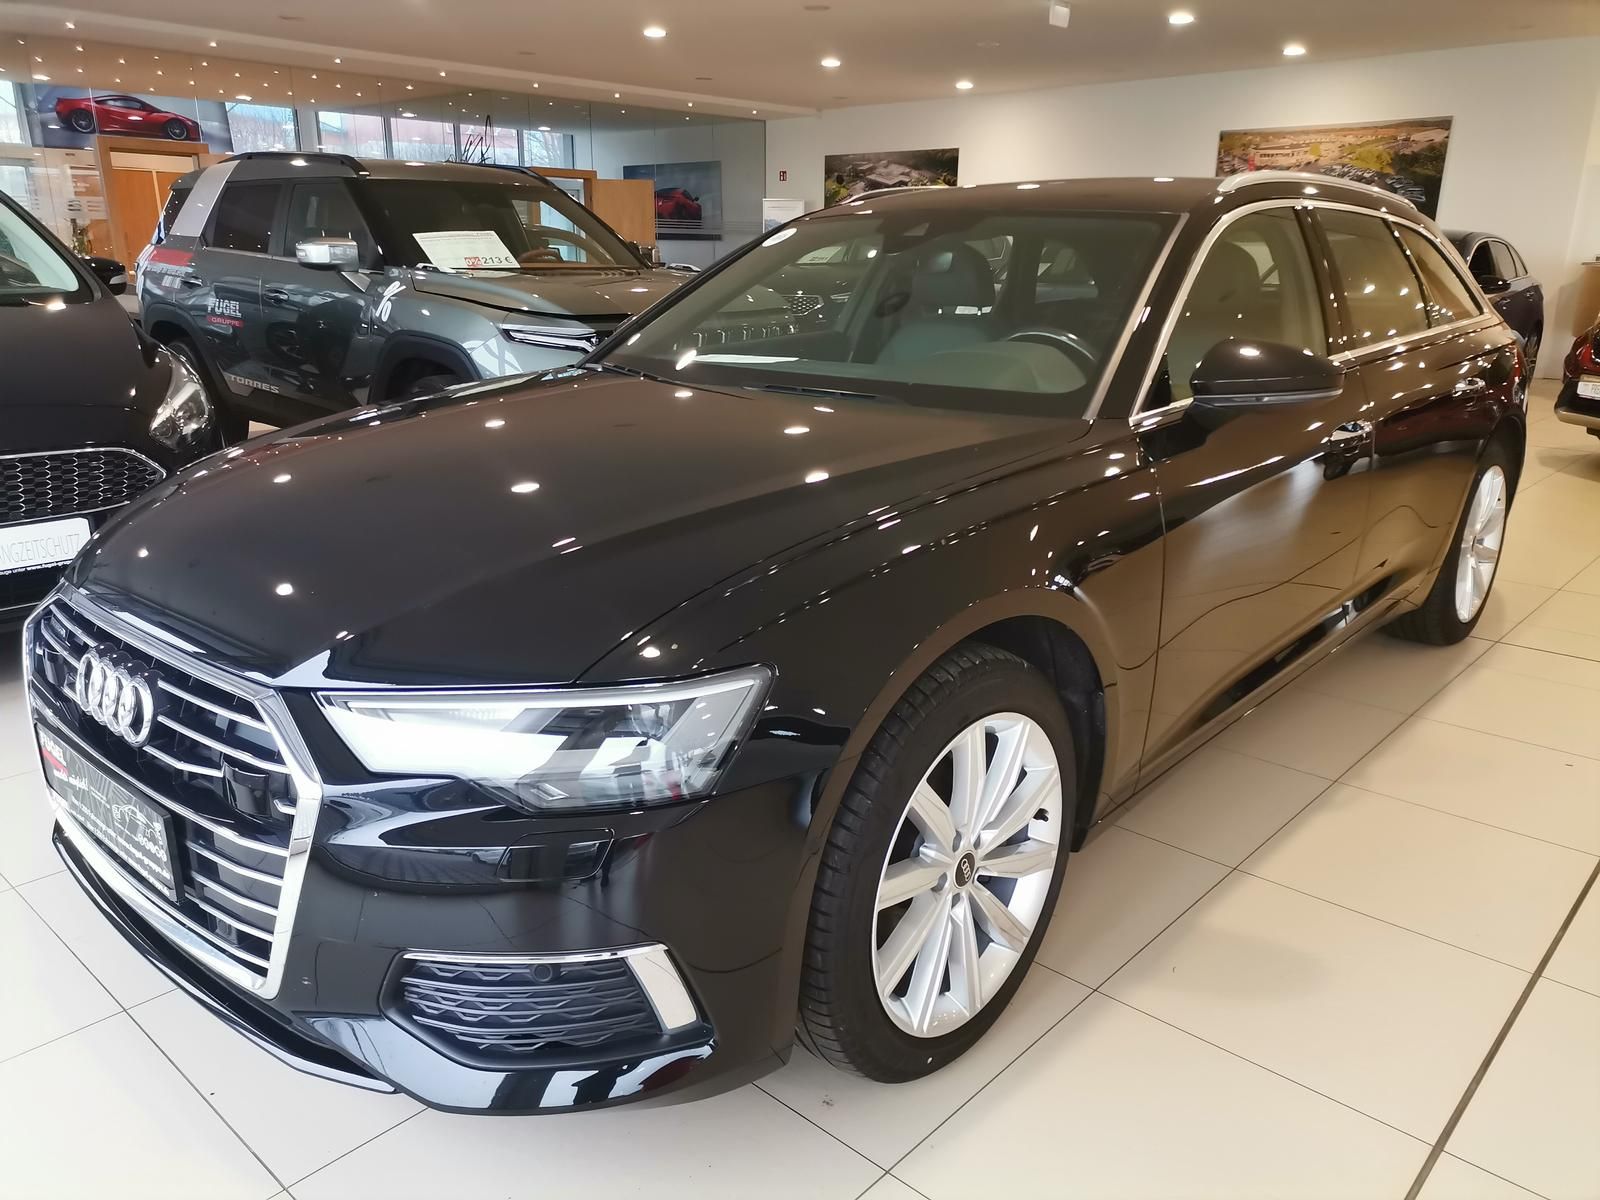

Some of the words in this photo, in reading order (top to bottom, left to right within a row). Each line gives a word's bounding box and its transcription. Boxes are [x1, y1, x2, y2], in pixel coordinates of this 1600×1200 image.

[481, 256, 502, 265] 213
[504, 256, 513, 264] €
[211, 317, 241, 327] GRUPPE
[231, 375, 280, 394] TORRES
[0, 533, 80, 563] NGZEITSCHUTZ
